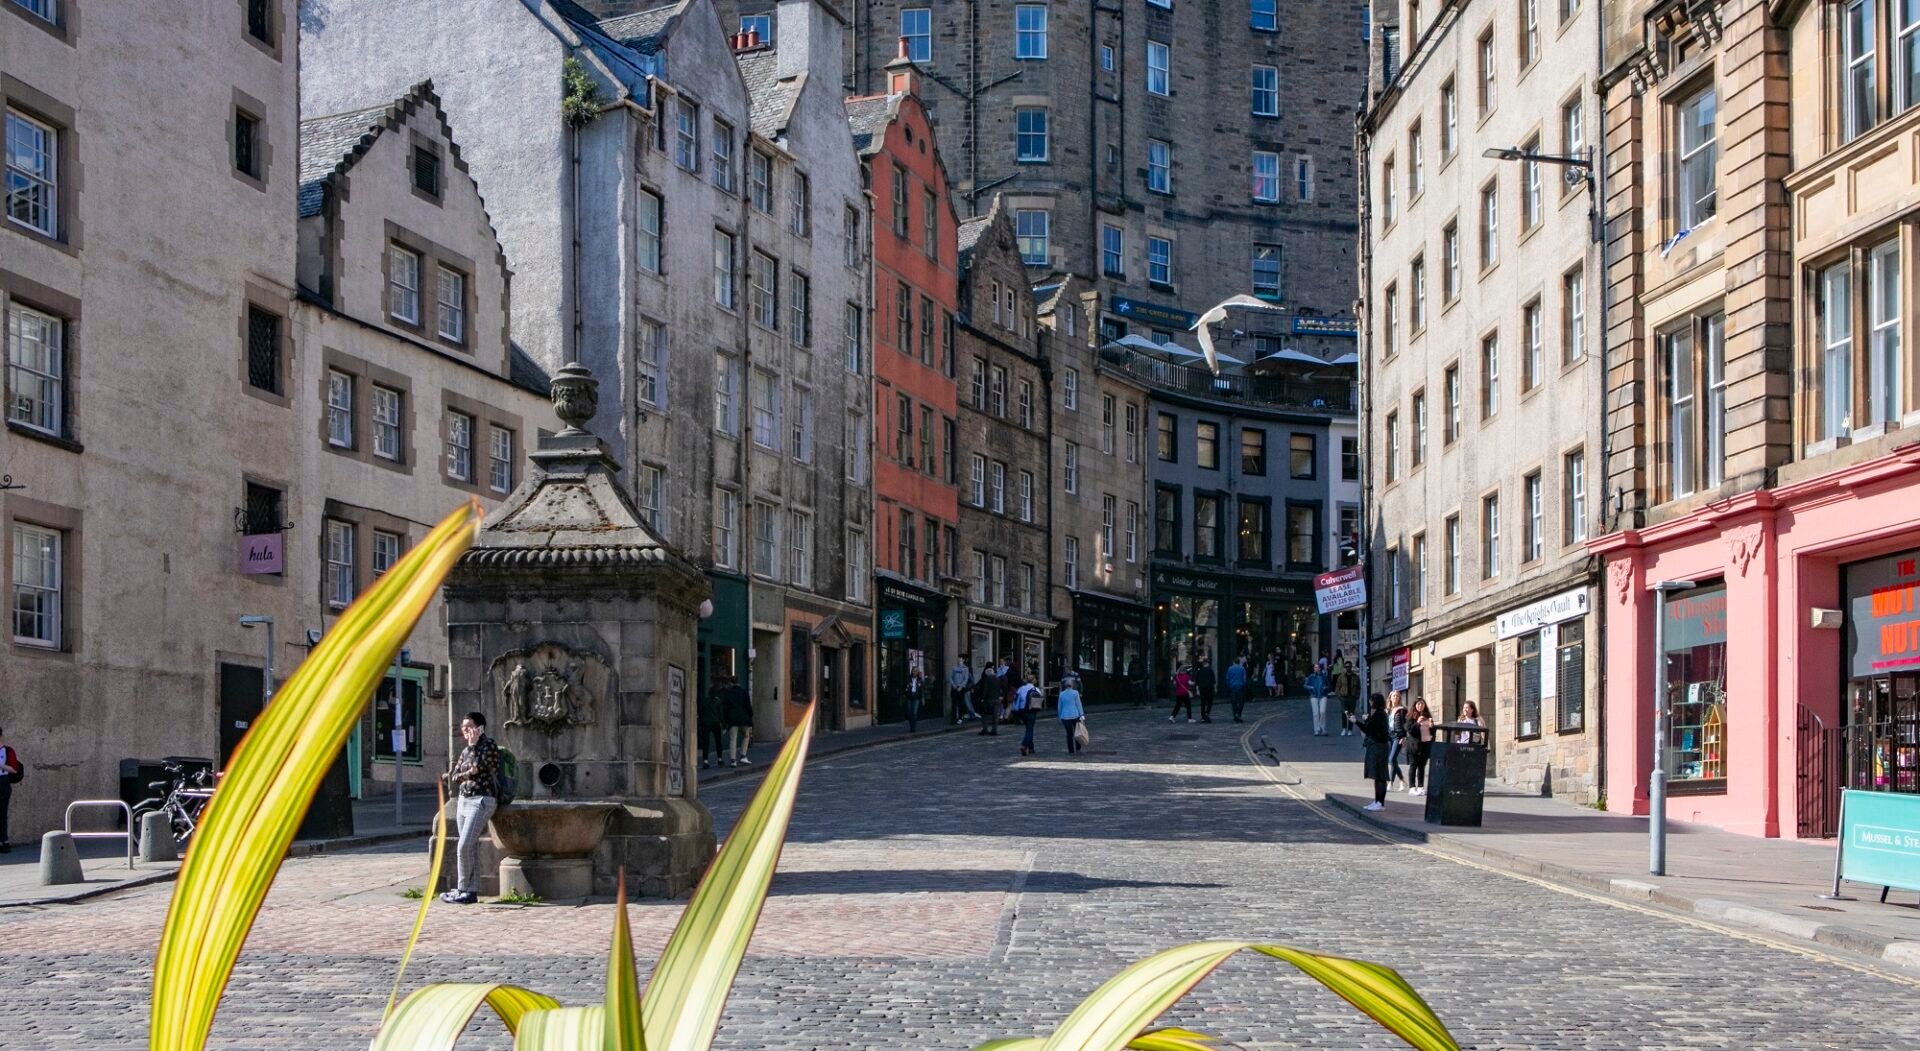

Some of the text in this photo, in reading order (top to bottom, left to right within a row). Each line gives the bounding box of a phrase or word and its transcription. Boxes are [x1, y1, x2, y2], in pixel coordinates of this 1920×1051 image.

[249, 545, 273, 561] hula
[1897, 560, 1916, 577] THE
[1320, 570, 1357, 586] Culverwell
[1322, 588, 1361, 602] AVAILABLE
[1329, 584, 1352, 593] LEASE
[1338, 597, 1348, 605] 226
[1872, 580, 1920, 618] MUT
[1512, 613, 1524, 627] The
[1551, 596, 1571, 613] Vault
[1895, 835, 1902, 846] &
